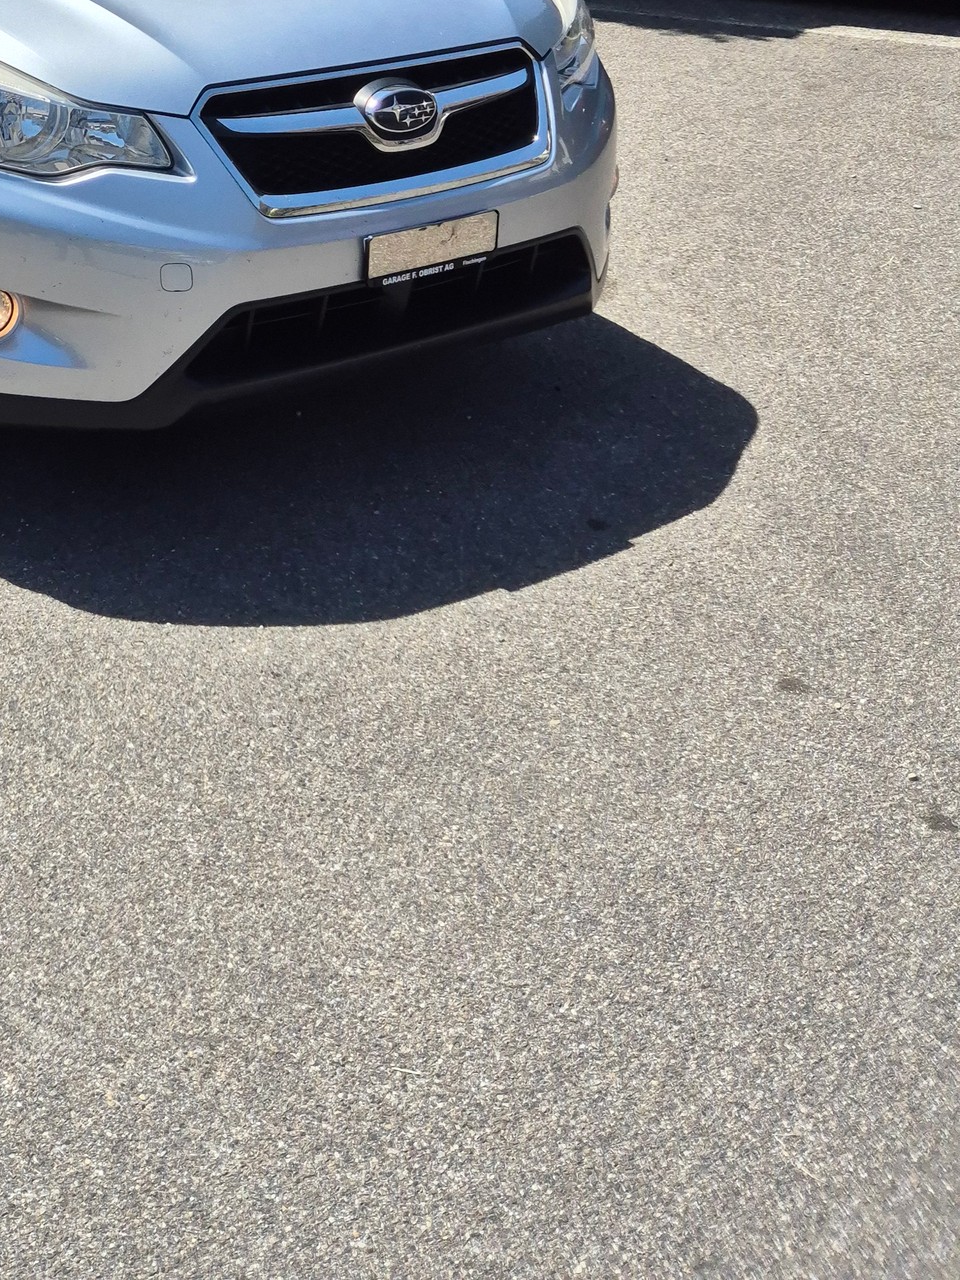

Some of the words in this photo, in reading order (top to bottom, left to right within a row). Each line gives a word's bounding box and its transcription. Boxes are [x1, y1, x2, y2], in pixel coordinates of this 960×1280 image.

[382, 273, 411, 286] GARAGE
[412, 271, 417, 279] F.
[418, 265, 444, 278] OBRIST
[444, 262, 454, 272] AG
